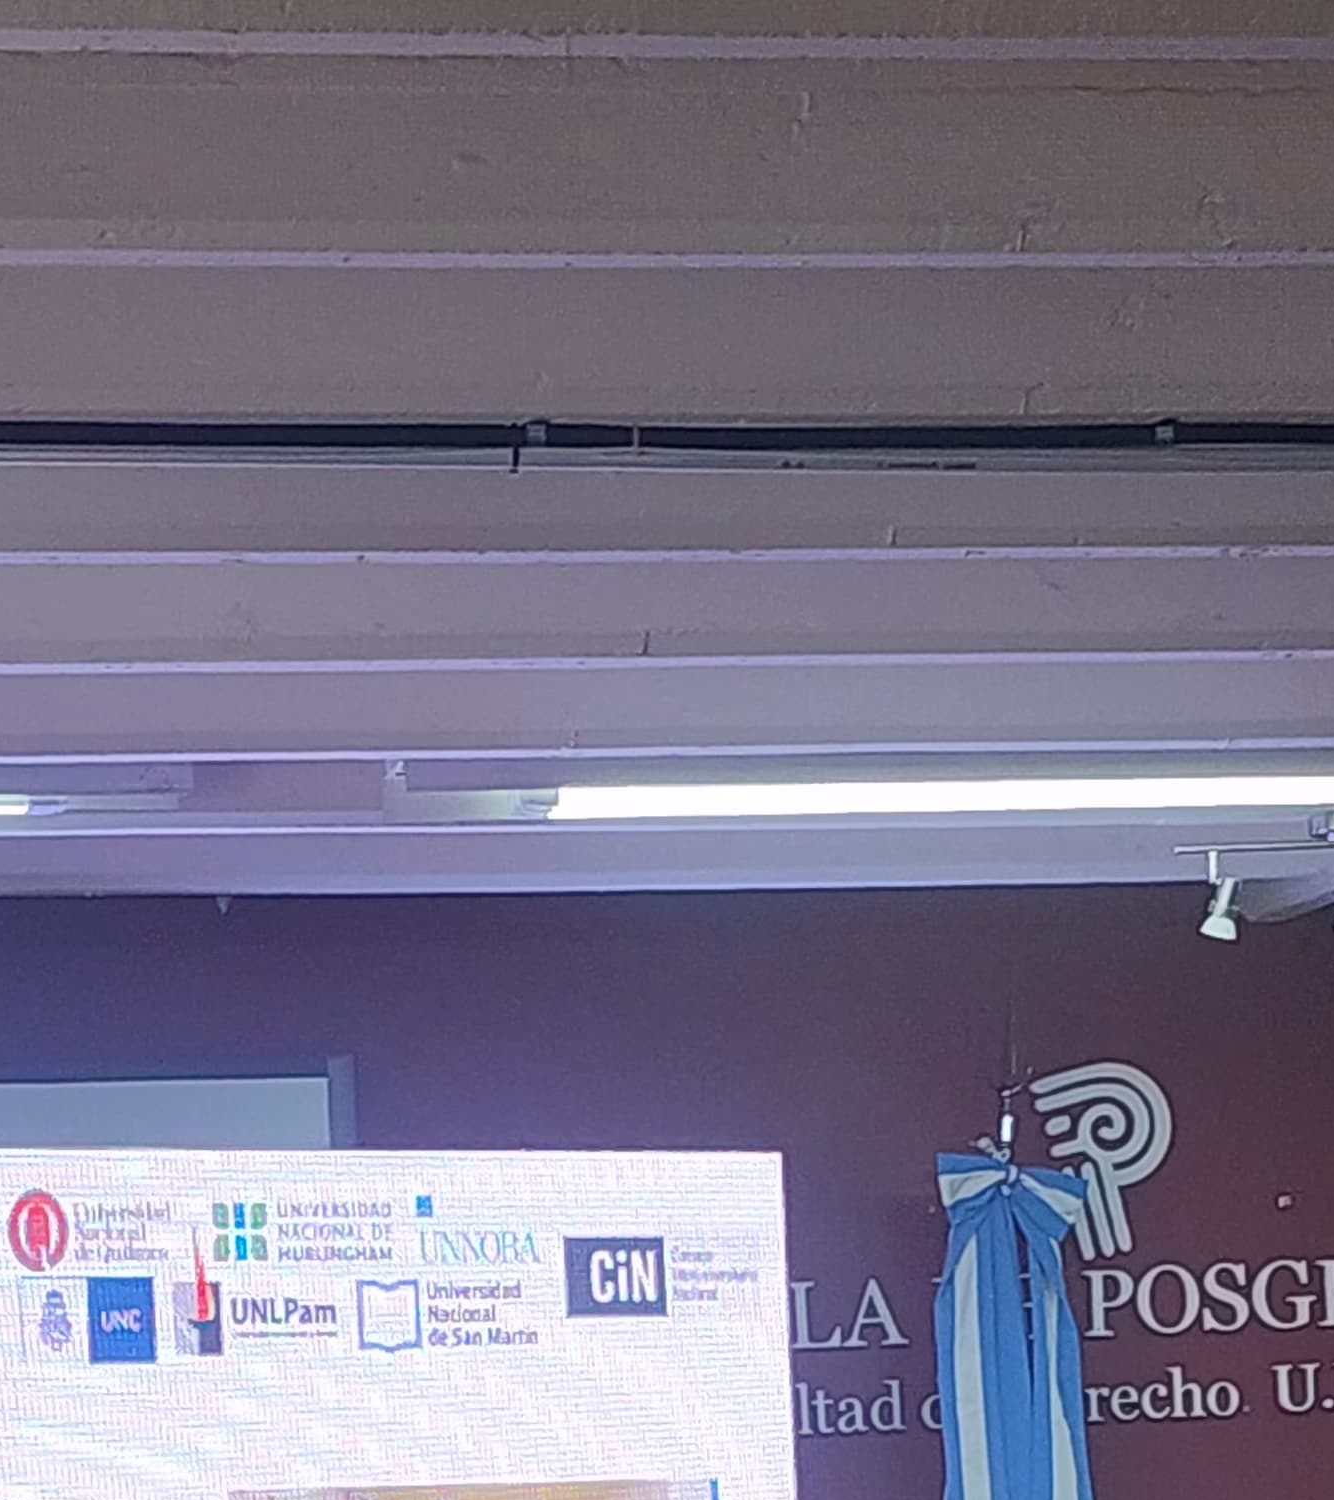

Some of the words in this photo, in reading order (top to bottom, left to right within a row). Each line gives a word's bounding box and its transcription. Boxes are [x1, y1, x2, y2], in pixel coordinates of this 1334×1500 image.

[426, 1279, 521, 1300] Universidad
[101, 1308, 142, 1333] UNC
[231, 1298, 337, 1325] UNLPam
